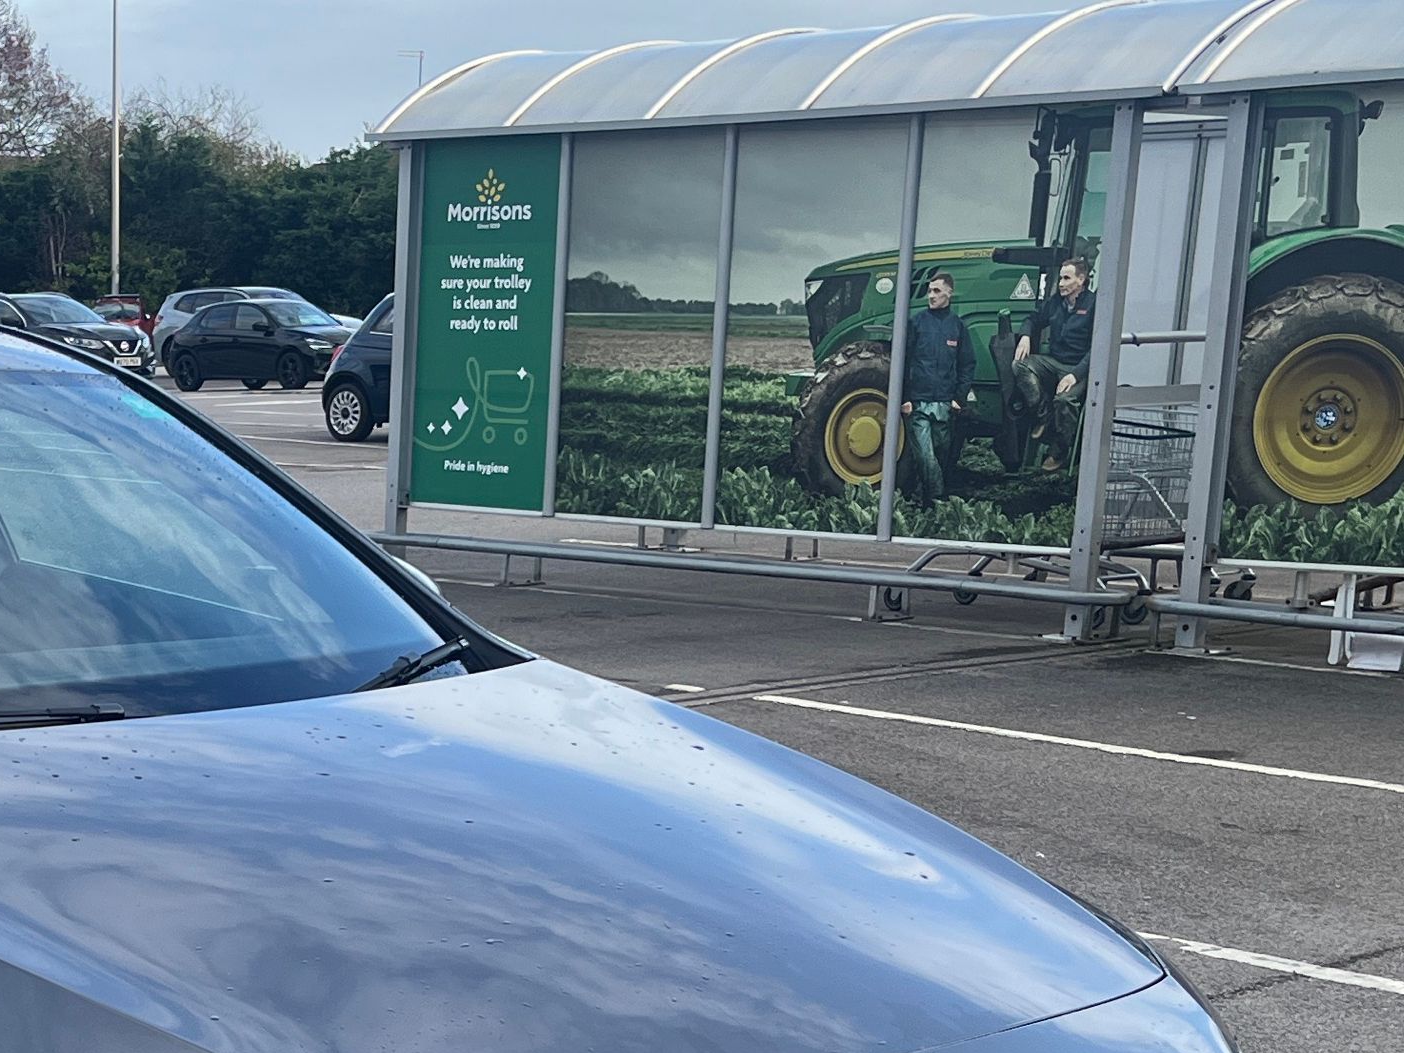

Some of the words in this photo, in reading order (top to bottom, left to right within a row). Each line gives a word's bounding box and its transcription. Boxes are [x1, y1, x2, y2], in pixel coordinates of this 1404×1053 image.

[448, 199, 532, 222] Morrisons
[450, 255, 481, 269] We're
[483, 253, 524, 272] making
[441, 279, 464, 289] sure
[466, 279, 492, 293] your
[494, 274, 532, 293] trolley
[453, 295, 462, 309] is
[464, 294, 493, 309] clean
[495, 294, 517, 309] and
[450, 315, 481, 334] ready
[483, 318, 496, 330] to
[498, 315, 518, 330] roll
[444, 459, 466, 471] Pride
[467, 461, 475, 471] in
[476, 460, 509, 475] hygiene
